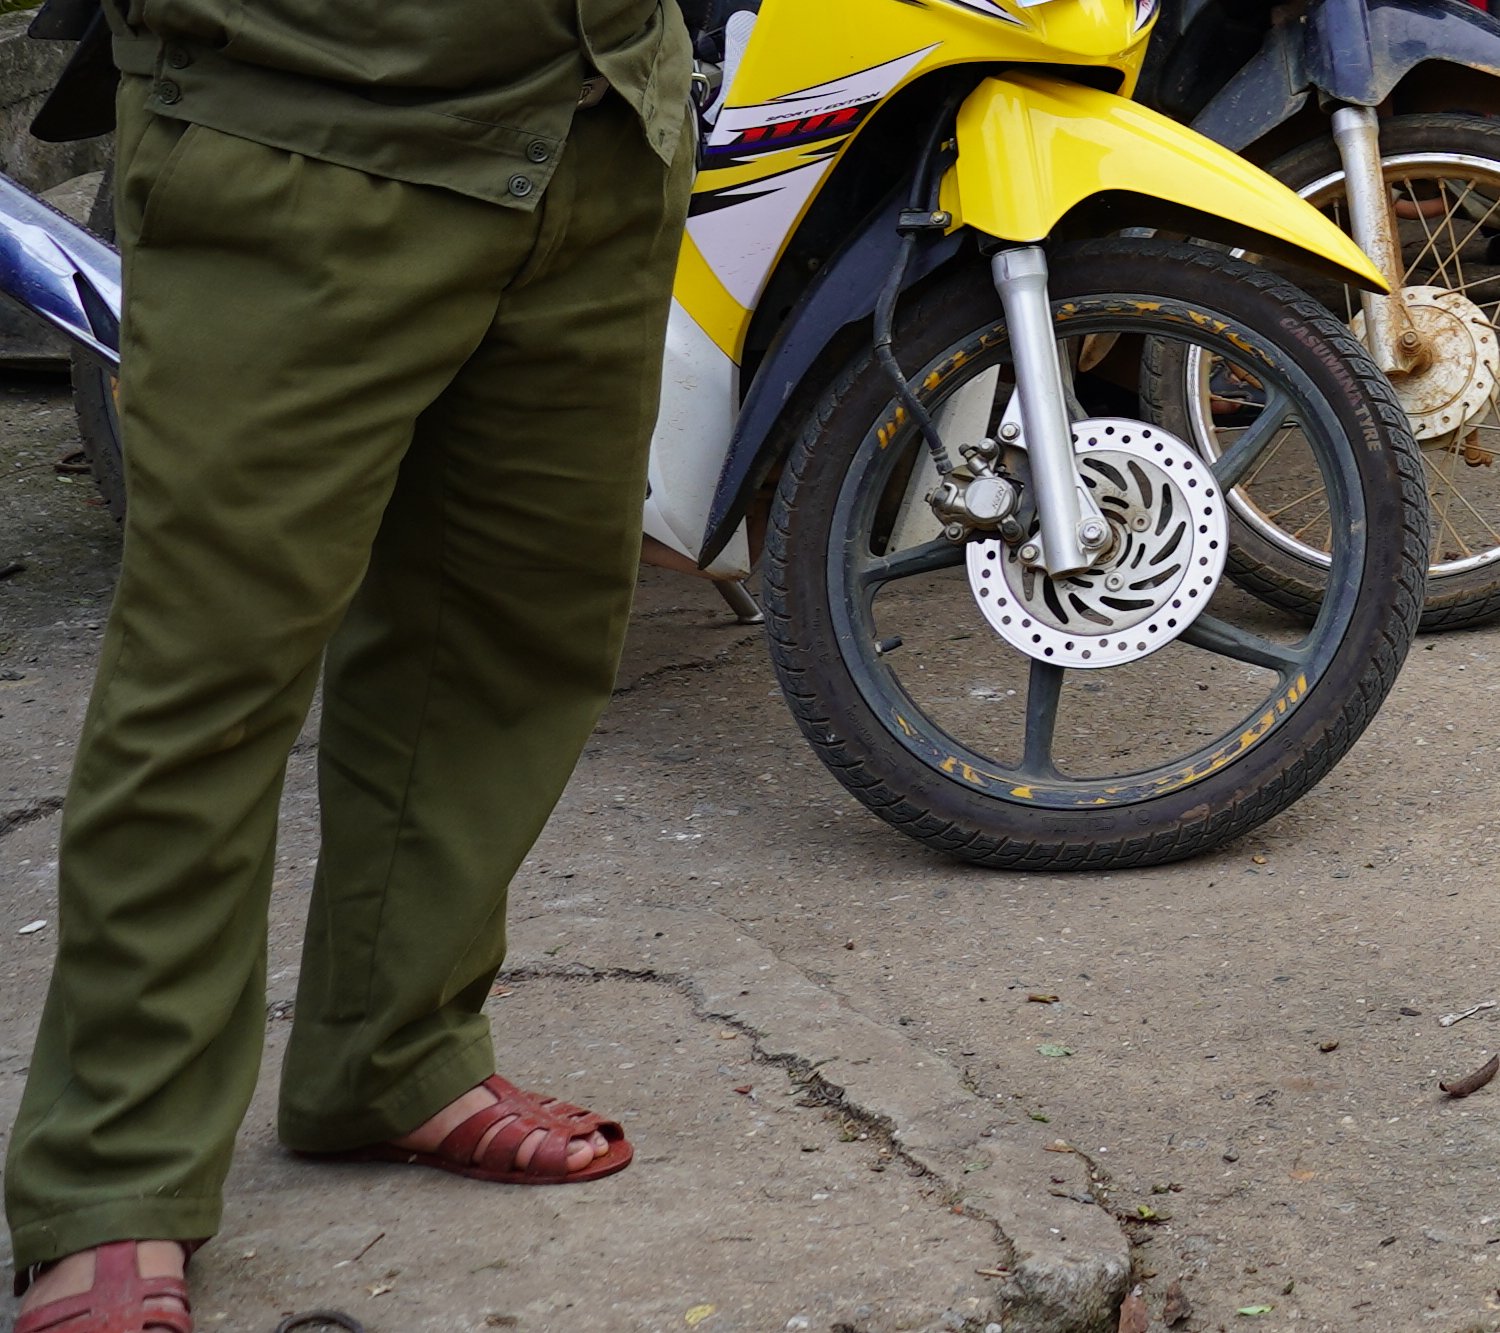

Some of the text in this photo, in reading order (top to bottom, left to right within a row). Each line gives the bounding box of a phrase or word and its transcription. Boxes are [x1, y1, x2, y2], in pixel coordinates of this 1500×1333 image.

[764, 90, 881, 122] SPORTY EDITION
[1279, 316, 1383, 452] CASUMINA TYRE
